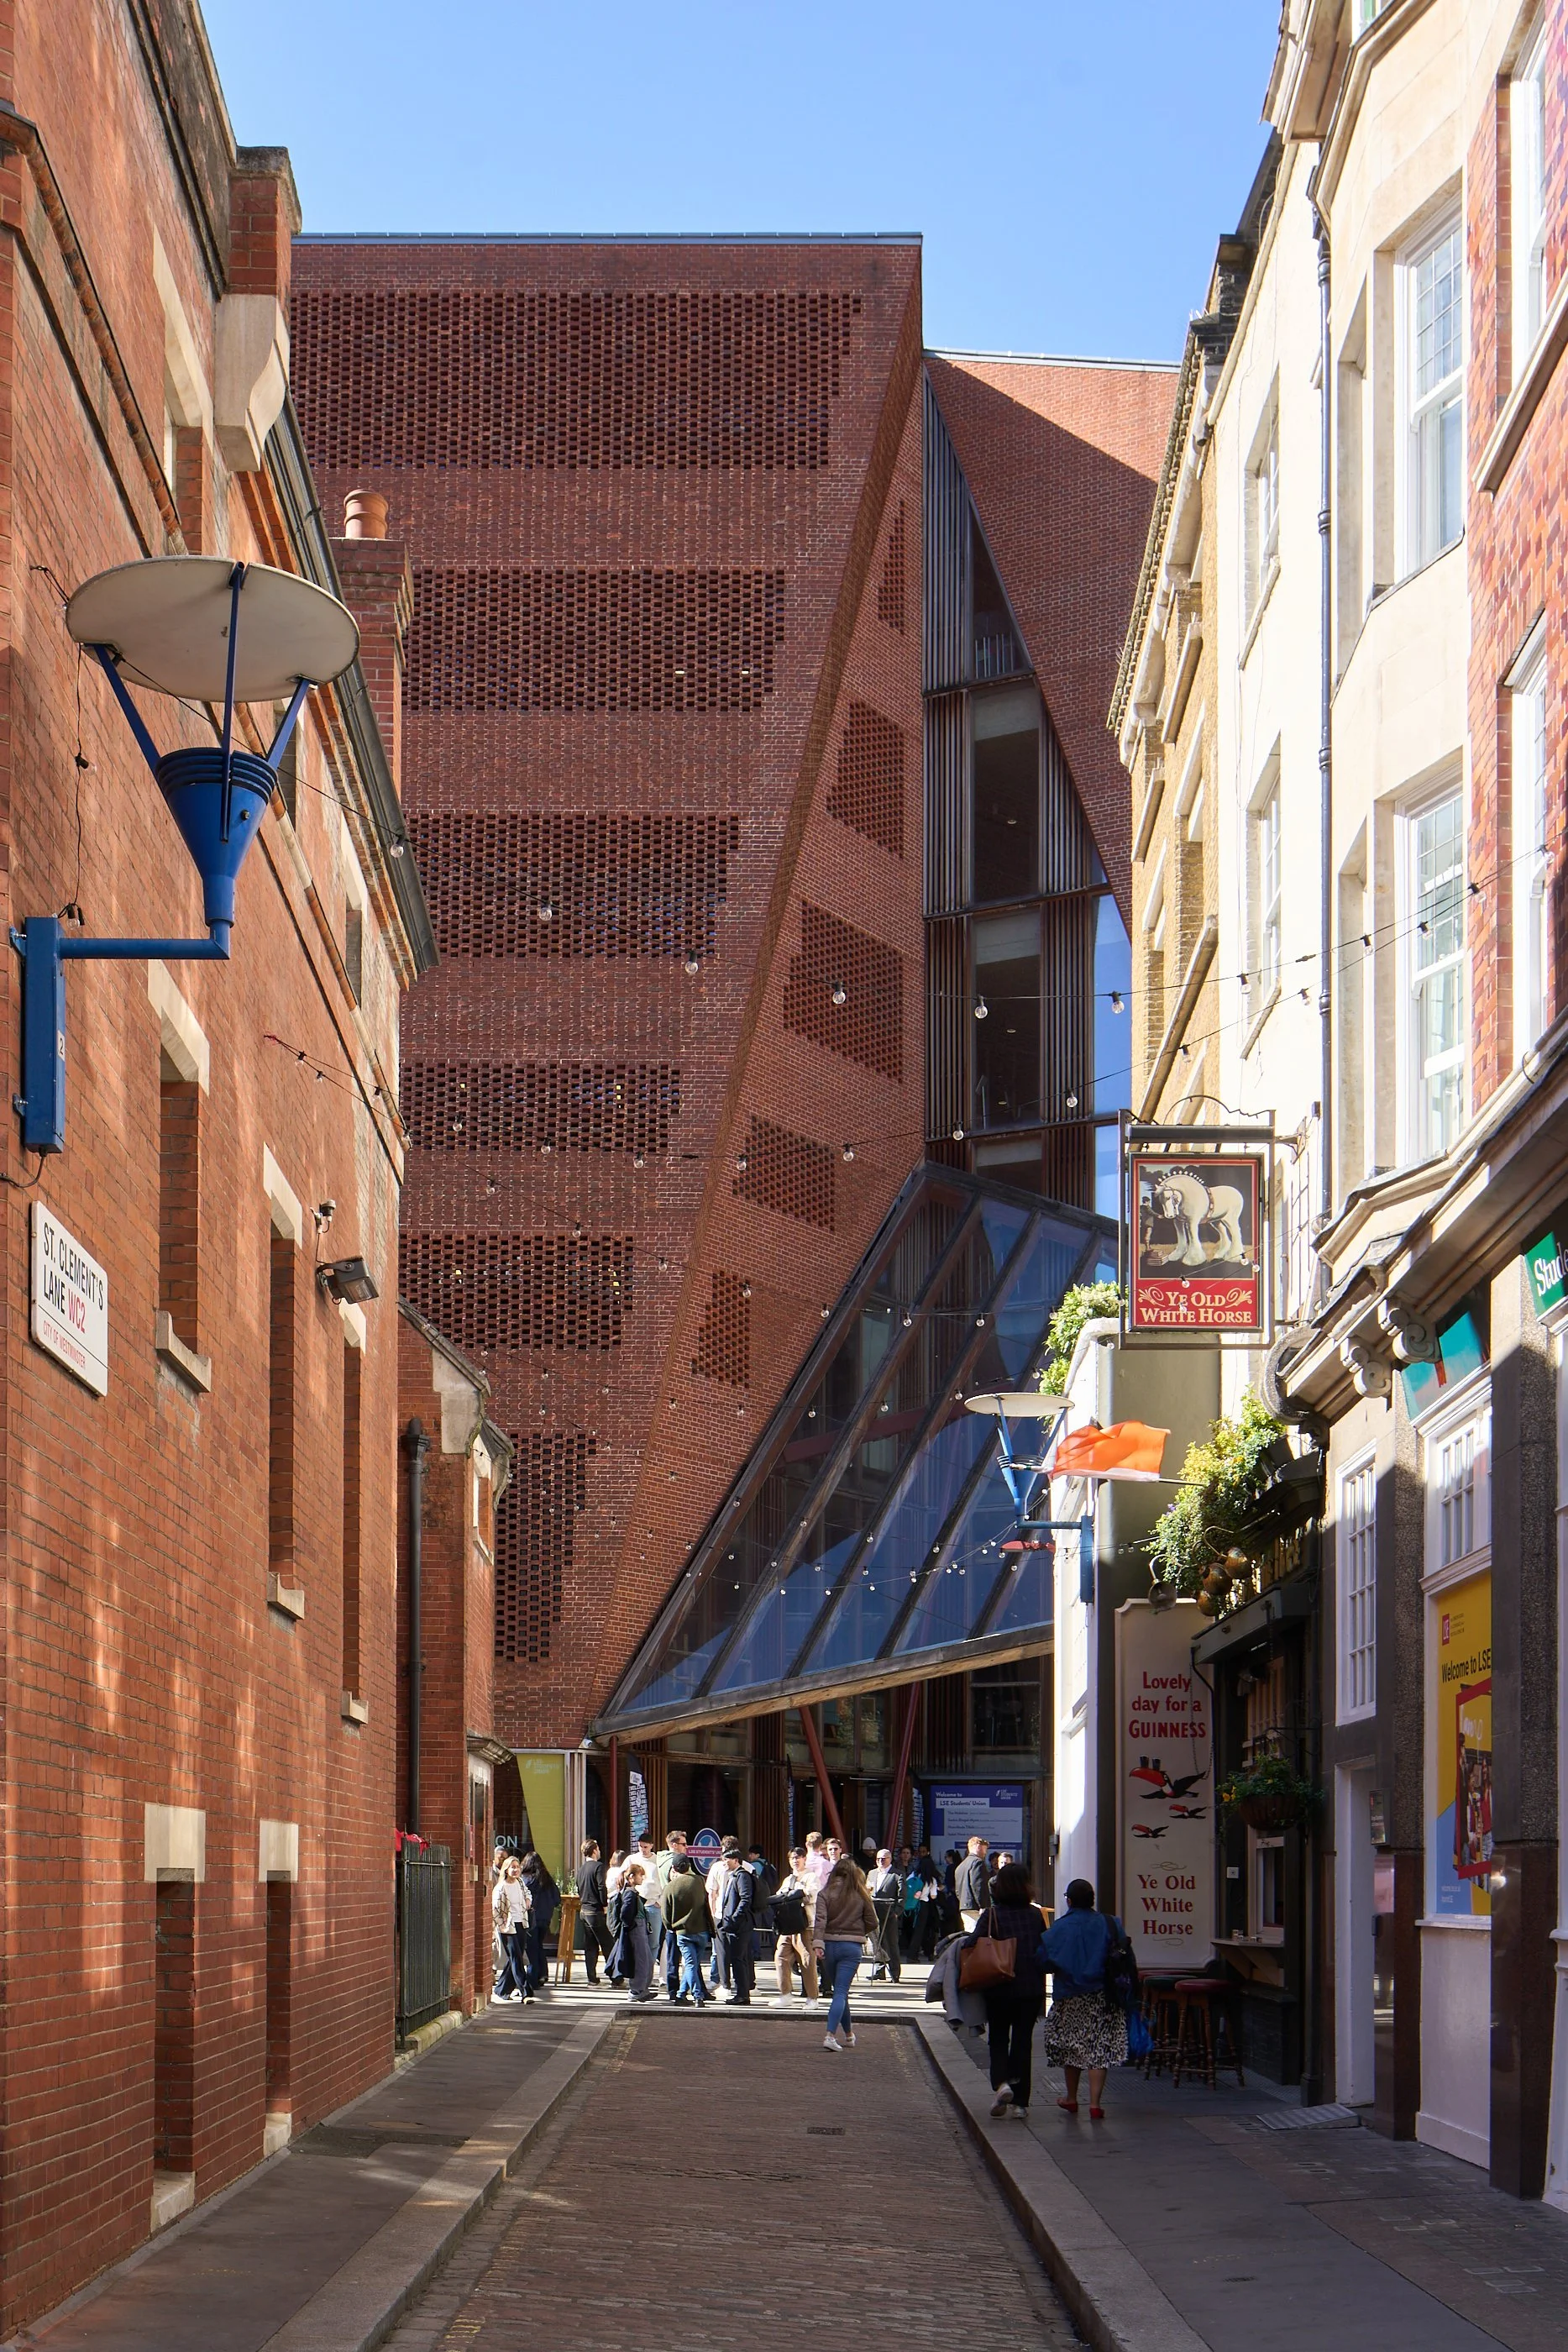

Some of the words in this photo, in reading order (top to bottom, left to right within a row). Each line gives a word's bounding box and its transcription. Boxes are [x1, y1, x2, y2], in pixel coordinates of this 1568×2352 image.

[44, 1222, 56, 1263] ST.
[60, 1238, 103, 1310] CLEMENT'S
[44, 1264, 66, 1315] LANE
[68, 1289, 86, 1334] WC2
[1191, 1292, 1226, 1307] OLD
[1141, 1308, 1196, 1323] WHITE
[1199, 1308, 1252, 1323] HORSE
[44, 1320, 52, 1338] CITY
[53, 1330, 59, 1344] OF
[59, 1335, 86, 1370] WESTMINSTER
[1442, 1660, 1469, 1683] Welcome
[1471, 1656, 1476, 1674] to
[1478, 1648, 1492, 1672] LSE
[1143, 1672, 1191, 1692] Lovely
[1131, 1697, 1159, 1714] day
[1166, 1696, 1188, 1712] for
[1192, 1700, 1202, 1712] a
[1129, 1719, 1206, 1739] GUINNESS
[495, 1835, 517, 1848] ON
[1137, 1875, 1158, 1891] Ye
[1165, 1874, 1196, 1890] Old
[1141, 1896, 1193, 1913] White
[1143, 1919, 1193, 1935] Horse
